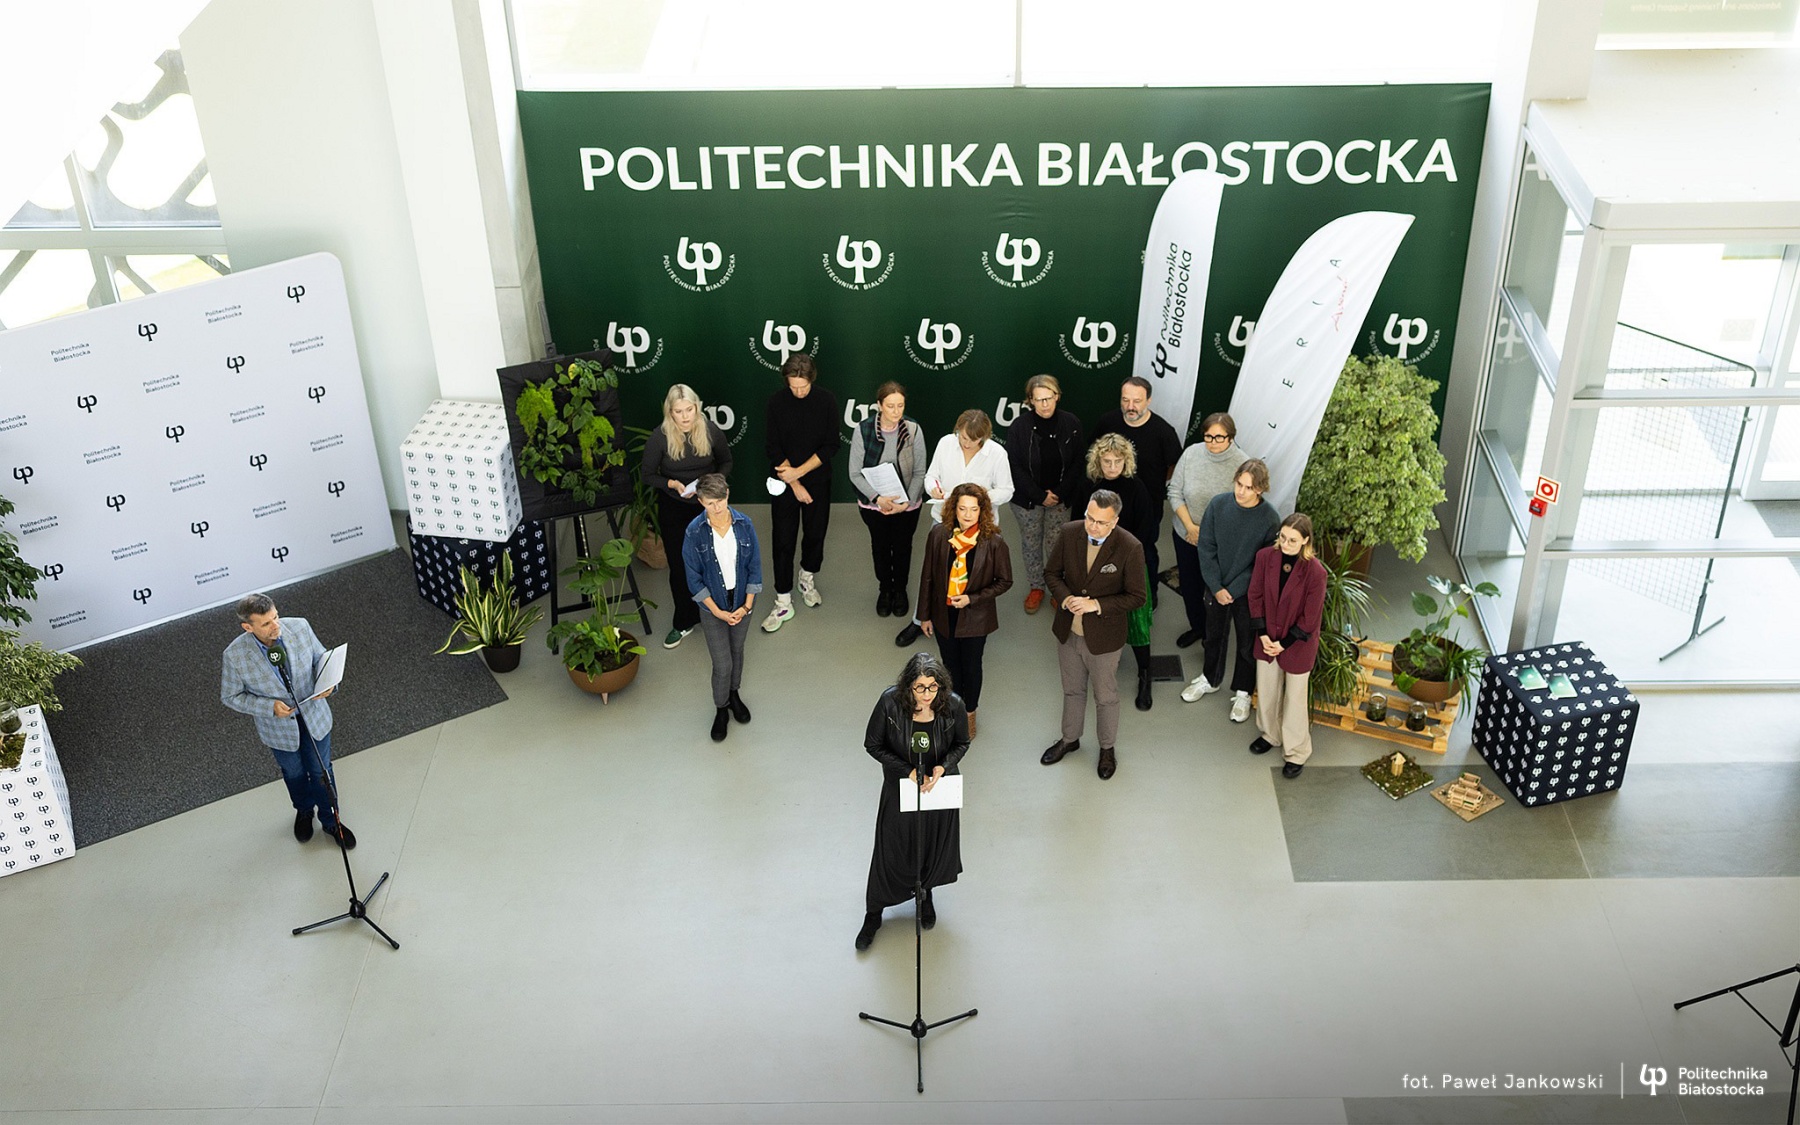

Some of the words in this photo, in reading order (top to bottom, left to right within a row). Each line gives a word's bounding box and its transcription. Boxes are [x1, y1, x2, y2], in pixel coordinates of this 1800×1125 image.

[579, 143, 1024, 191] POLITECHNIKA
[1037, 138, 1459, 188] BIAŁOSTOCKA
[663, 254, 702, 292] POLITECHNIKA
[704, 253, 736, 292] BIAŁOSTOCKA
[822, 253, 860, 291] POLITECHNIKA
[863, 251, 895, 291] BIAŁOSTOCKA
[981, 250, 1018, 288] POLITECHNIKA
[1020, 249, 1055, 288] BIAŁOSTOCKA
[1168, 249, 1193, 349] Białostocka
[634, 337, 664, 374] BIAŁOSTOCKA
[748, 336, 782, 372] POLITECHNIK
[903, 335, 940, 371] POLITECHNIKA
[942, 333, 975, 371] BIAŁOSTOCKA
[1058, 333, 1093, 369] POLITECHNIKA
[1096, 332, 1130, 369] BIAŁOSTOCKA
